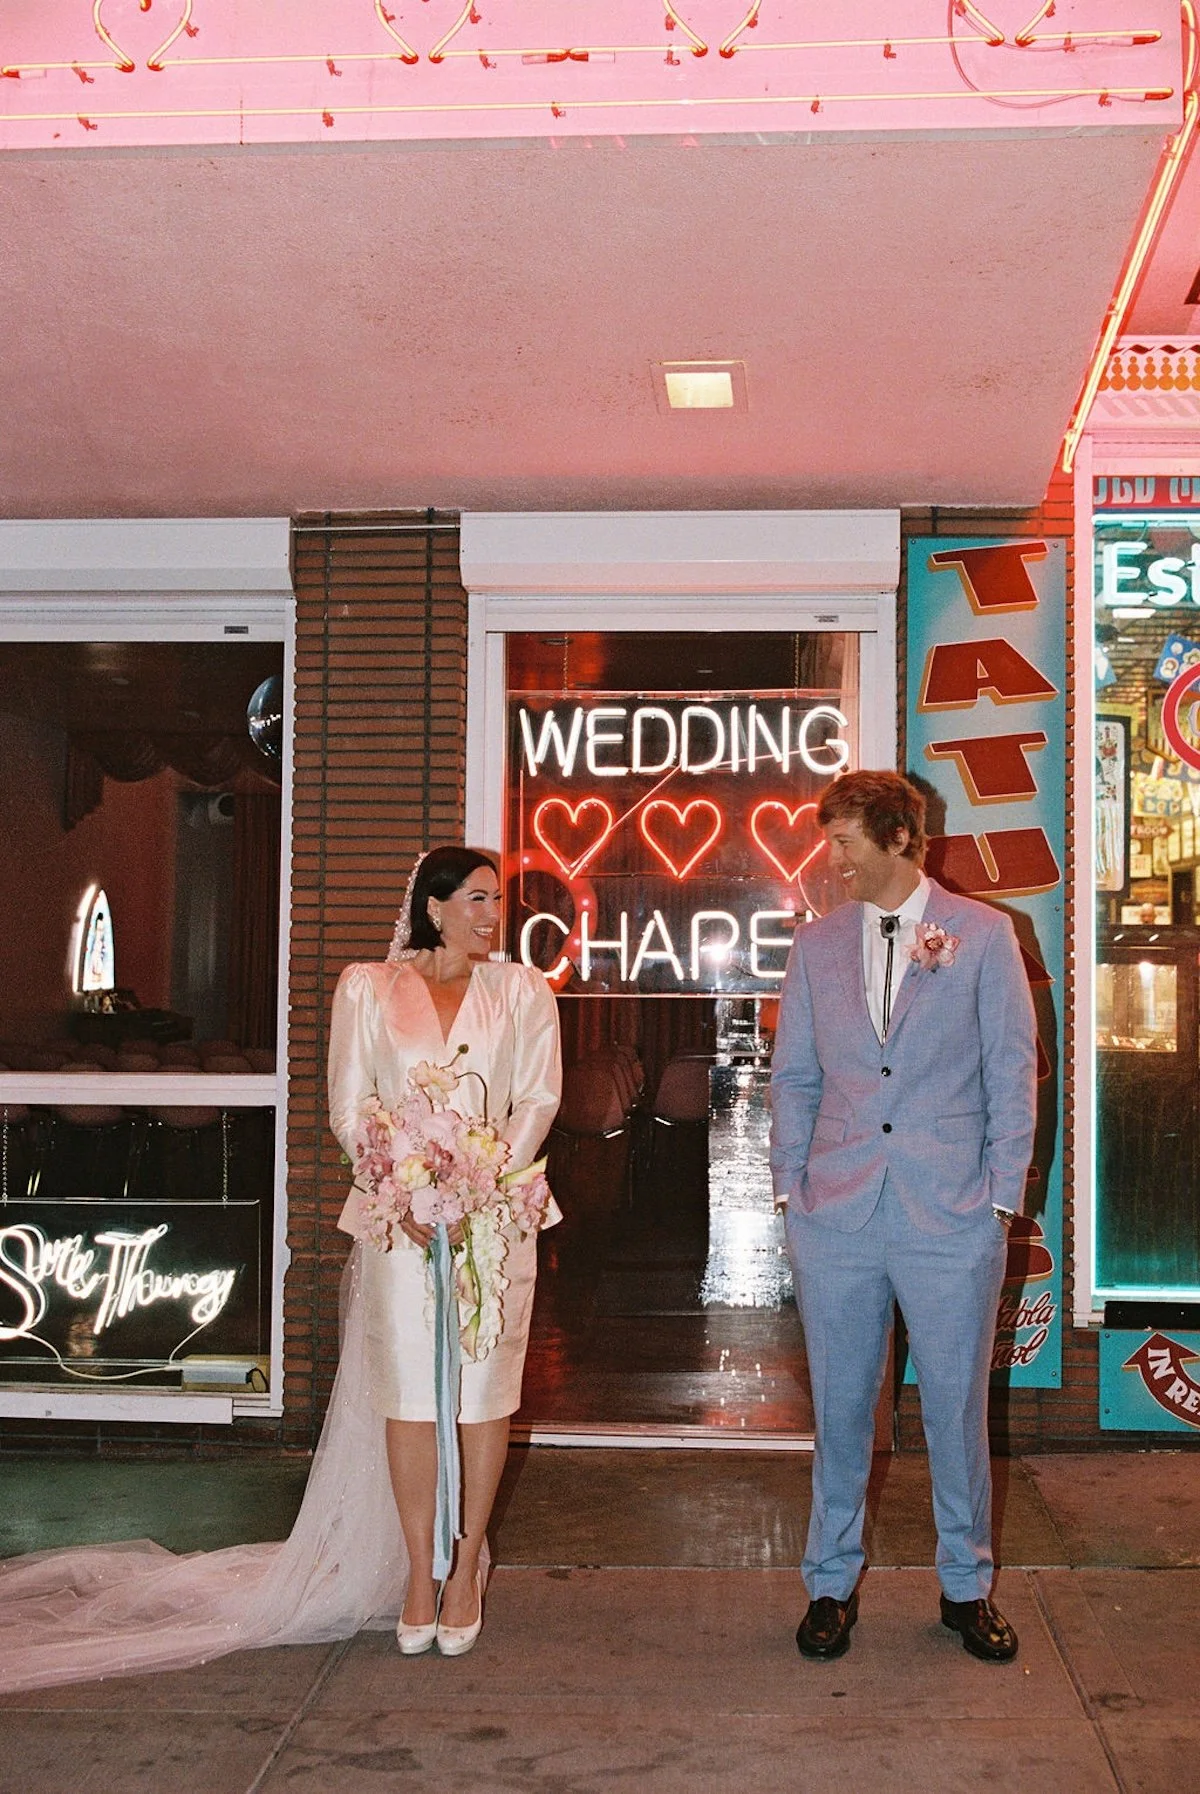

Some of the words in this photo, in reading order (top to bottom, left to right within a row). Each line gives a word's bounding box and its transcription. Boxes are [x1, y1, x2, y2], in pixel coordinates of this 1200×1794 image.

[519, 705, 849, 777] WEDDING
[520, 909, 814, 983] CHAPE
[1147, 1347, 1177, 1381] IN
[1164, 1376, 1200, 1416] RE
